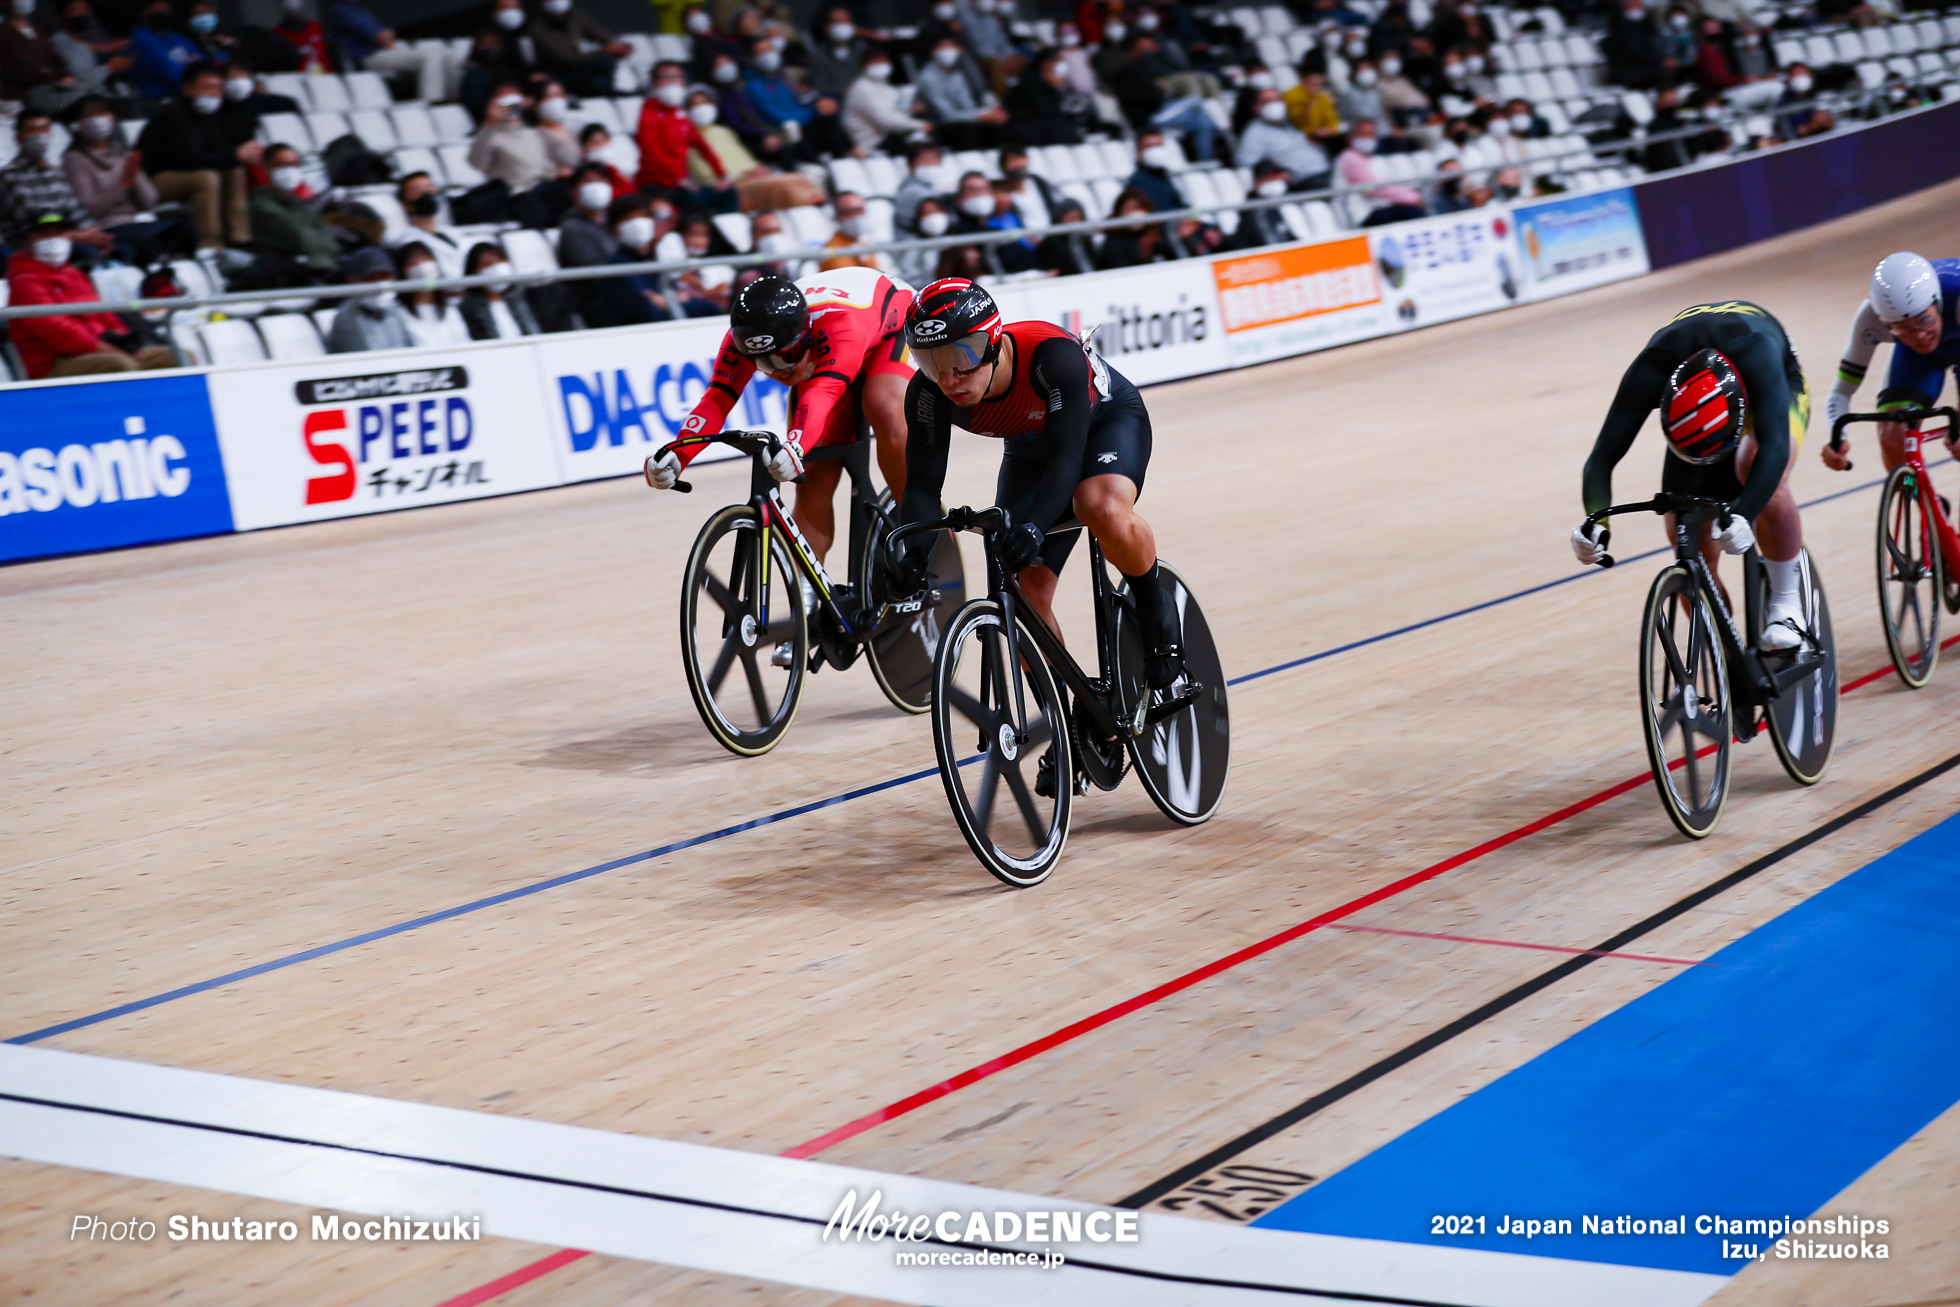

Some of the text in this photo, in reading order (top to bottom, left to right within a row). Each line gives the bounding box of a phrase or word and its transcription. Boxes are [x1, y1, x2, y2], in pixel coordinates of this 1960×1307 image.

[968, 296, 993, 318] JAPAN
[916, 333, 948, 343] Kabuto
[303, 397, 473, 505] SPEED
[366, 460, 490, 497] チャンネル
[769, 487, 836, 594] LOOK
[894, 601, 922, 614] T20
[1159, 1165, 1317, 1221] 250
